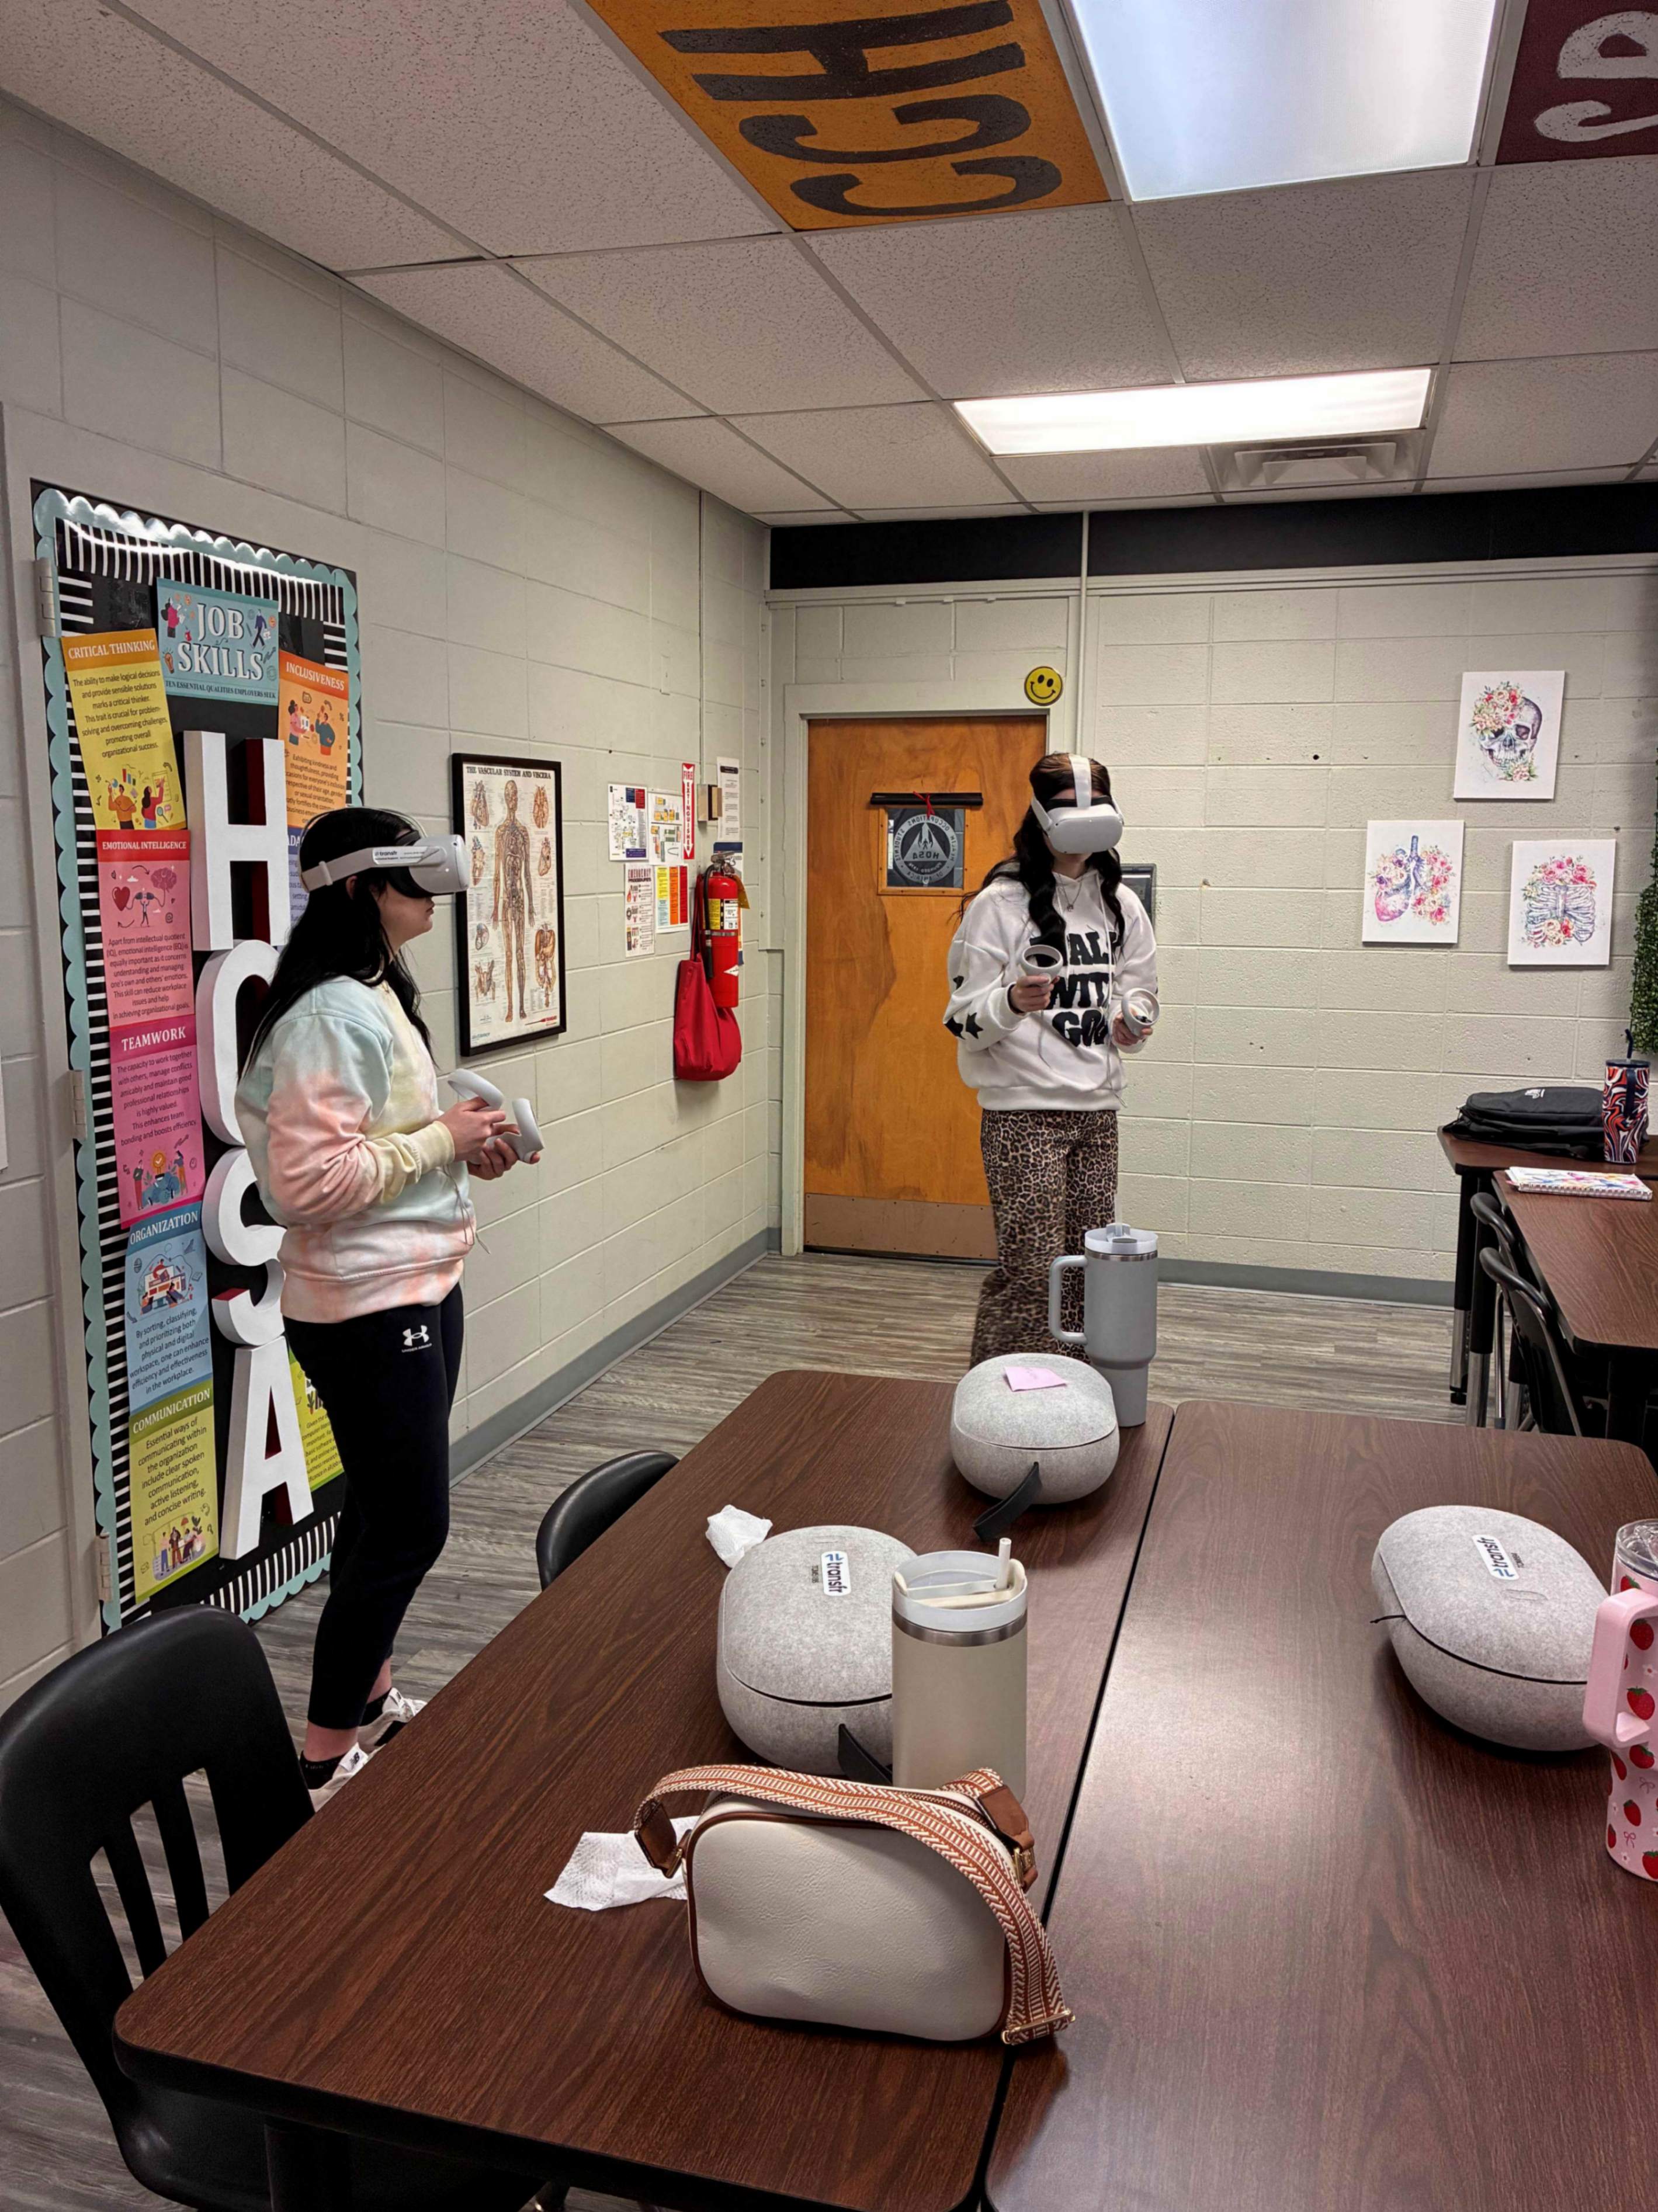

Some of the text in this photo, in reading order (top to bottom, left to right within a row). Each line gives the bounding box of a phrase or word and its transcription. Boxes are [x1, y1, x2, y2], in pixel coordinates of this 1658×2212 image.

[196, 603, 244, 641] JOB
[68, 640, 155, 658] CRITICAL THINKING
[178, 641, 263, 680] SKILLS
[84, 677, 98, 685] ability
[105, 674, 119, 682] make
[120, 671, 137, 682] logical
[138, 670, 160, 678] decisions
[286, 661, 345, 691] INCLUSIVENESS
[82, 682, 156, 699] and provide sensible solutions
[176, 682, 204, 691] ESSENTIAL
[206, 685, 234, 693] QUALITIES
[234, 688, 263, 697] EMPLOYERS
[92, 700, 108, 709] marks
[113, 696, 130, 706] critical
[85, 714, 95, 723] This
[96, 713, 106, 721] trait
[112, 709, 129, 718] crucial
[138, 706, 161, 716] problem-
[82, 727, 99, 735] solving
[100, 724, 110, 732] and
[110, 721, 141, 731] overcoming
[105, 730, 151, 746] promoting overall
[102, 744, 137, 758] organizational
[478, 767, 502, 775] VASCULAR
[683, 770, 693, 780] FIRE
[108, 937, 122, 947] Apart
[136, 933, 163, 943] intellectual
[164, 932, 185, 942] quotient
[117, 946, 143, 955] emotional
[144, 944, 172, 953] intelligence
[172, 942, 183, 952] (EQ)
[110, 958, 127, 968] equally
[128, 956, 153, 966] important
[113, 963, 183, 977] understanding and managing
[110, 980, 123, 988] one's
[135, 976, 145, 985] and
[145, 974, 163, 983] others'
[124, 988, 133, 996] skill
[143, 985, 161, 994] reduce
[161, 982, 186, 991] workplace
[147, 995, 157, 1003] and
[158, 994, 169, 1002] help
[119, 1009, 140, 1018] achieving
[141, 1003, 175, 1016] organizational
[122, 1026, 186, 1051] TEAMWORK
[117, 1050, 192, 1073] The capacity work together
[118, 1076, 129, 1085] with
[148, 1068, 170, 1078] manage
[171, 1062, 192, 1073] conflicts
[120, 1072, 192, 1097] amicably and maintain good
[124, 1087, 189, 1110] professional relationships
[141, 1105, 158, 1116] highly
[132, 1111, 184, 1130] This enhances team
[121, 1119, 196, 1145] bonding and boosts efficiency
[130, 1210, 197, 1245] ORGANIZATION
[136, 1329, 143, 1338] By
[139, 1318, 196, 1349] and prioritizing both
[141, 1329, 194, 1361] physical and digital
[160, 1354, 172, 1364] one
[173, 1349, 183, 1359] can
[184, 1337, 209, 1353] enhance
[132, 1349, 207, 1389] efficiency and effectiveness
[152, 1381, 161, 1391] the
[133, 1387, 210, 1434] COMMUNICATION
[146, 1416, 197, 1448] Essential ways of
[138, 1426, 206, 1466] communicating within
[148, 1442, 197, 1473] the organization
[142, 1451, 204, 1489] include clear spoken
[151, 1495, 169, 1510] active
[145, 1511, 157, 1526] and
[157, 1501, 181, 1519] concise
[1477, 1537, 1509, 1568] transfr
[827, 1562, 848, 1593] transfr
